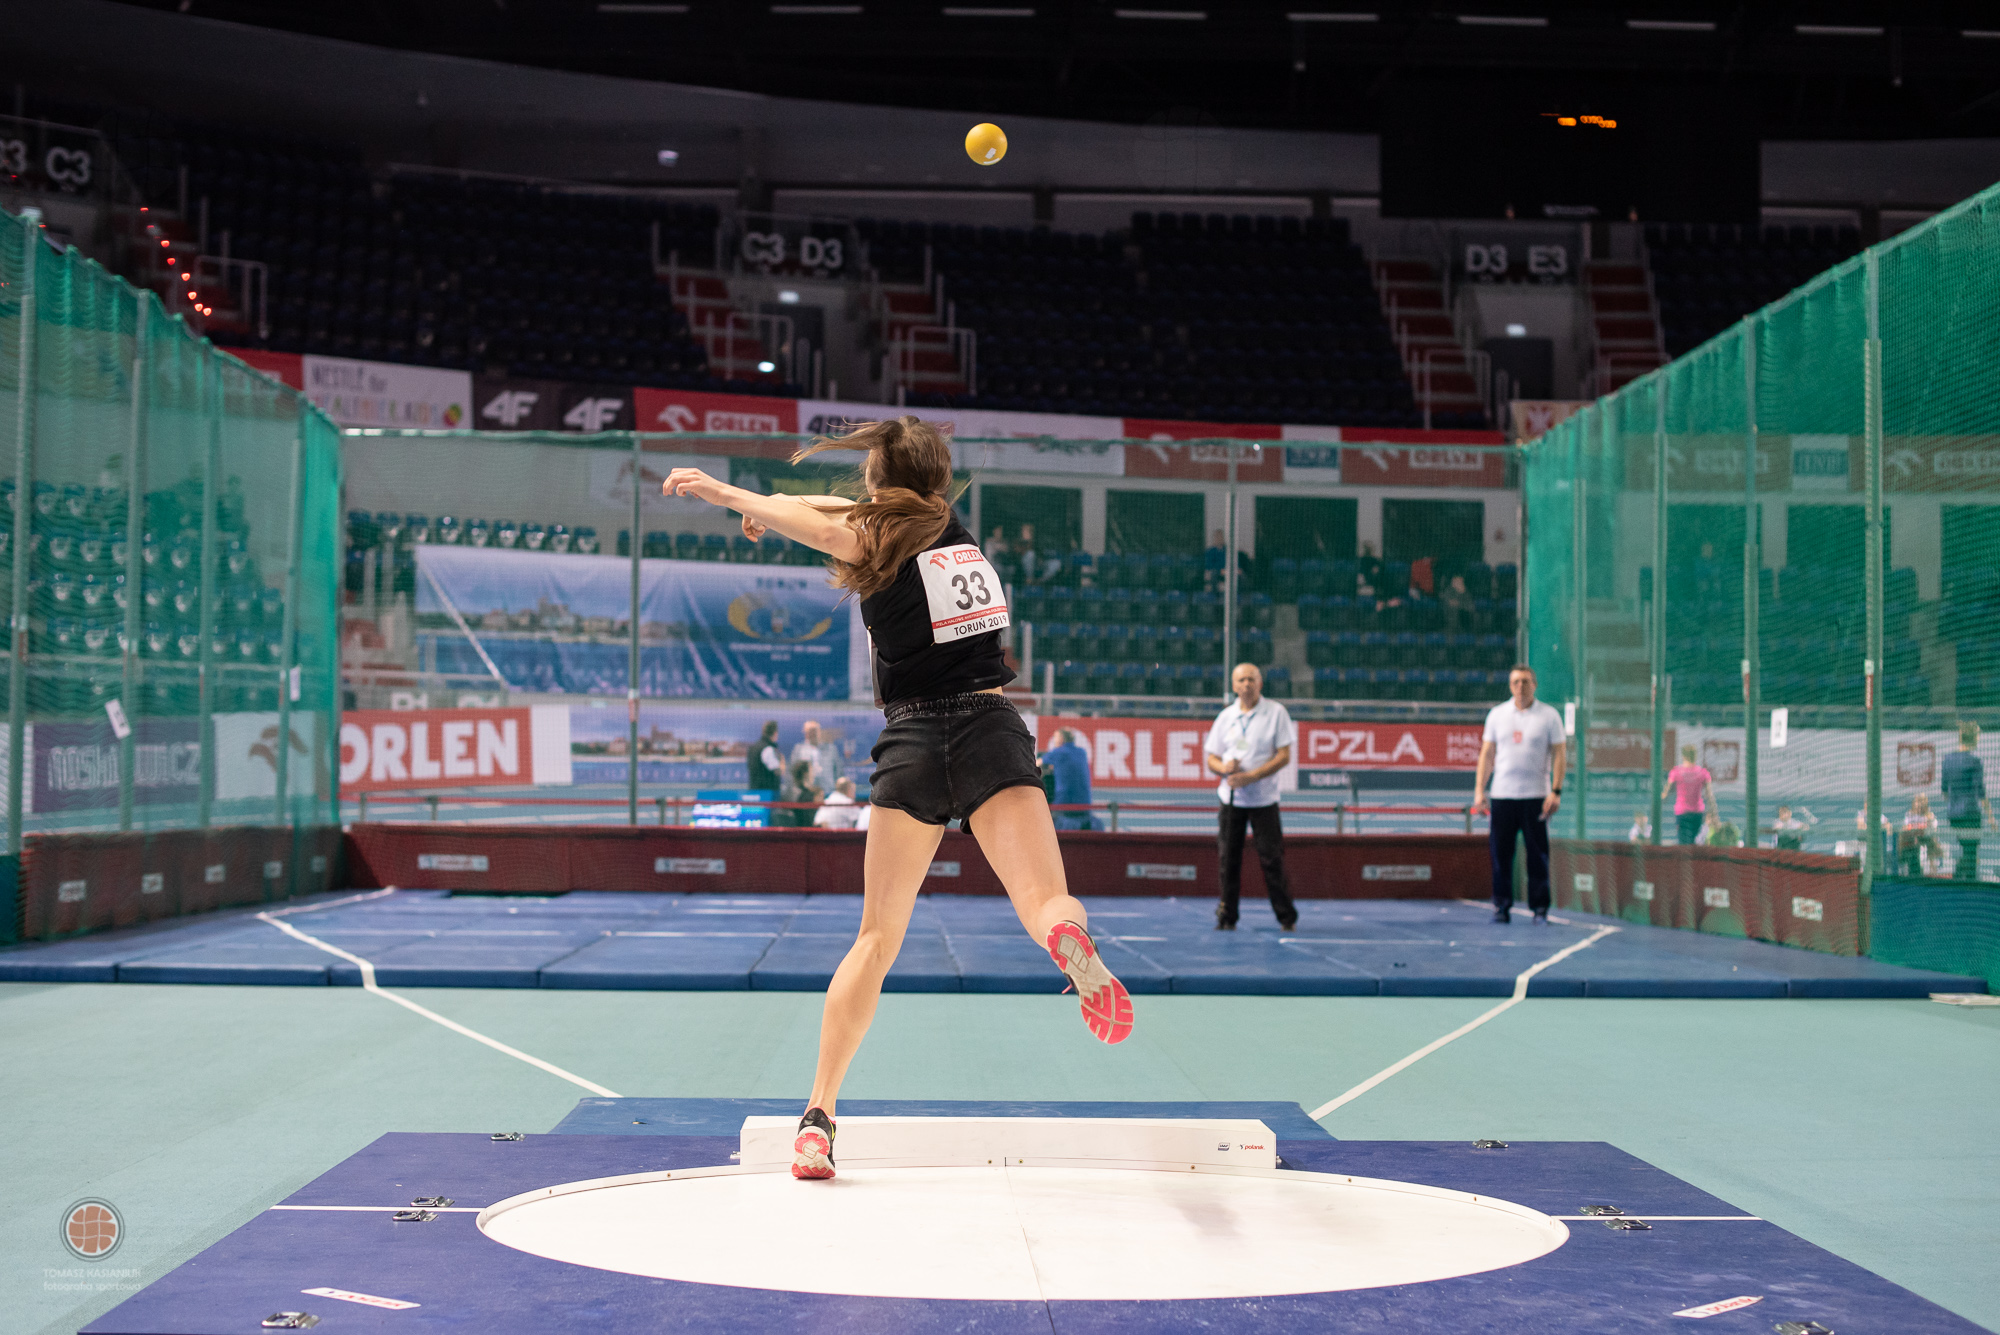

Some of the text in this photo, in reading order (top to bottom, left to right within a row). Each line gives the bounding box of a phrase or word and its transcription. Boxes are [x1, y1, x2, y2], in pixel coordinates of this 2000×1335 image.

[46, 146, 91, 185] C3
[743, 232, 784, 264] C3
[801, 236, 842, 269] D3
[1466, 244, 1507, 274] D3
[1529, 245, 1567, 275] E3
[482, 391, 538, 427] 4F
[563, 398, 624, 431] 4F
[955, 550, 983, 563] ORLEN
[951, 570, 991, 610] 33
[953, 615, 1007, 636] TORUŃ 2019
[340, 719, 518, 784] ORLEN
[1308, 729, 1425, 763] PZLA
